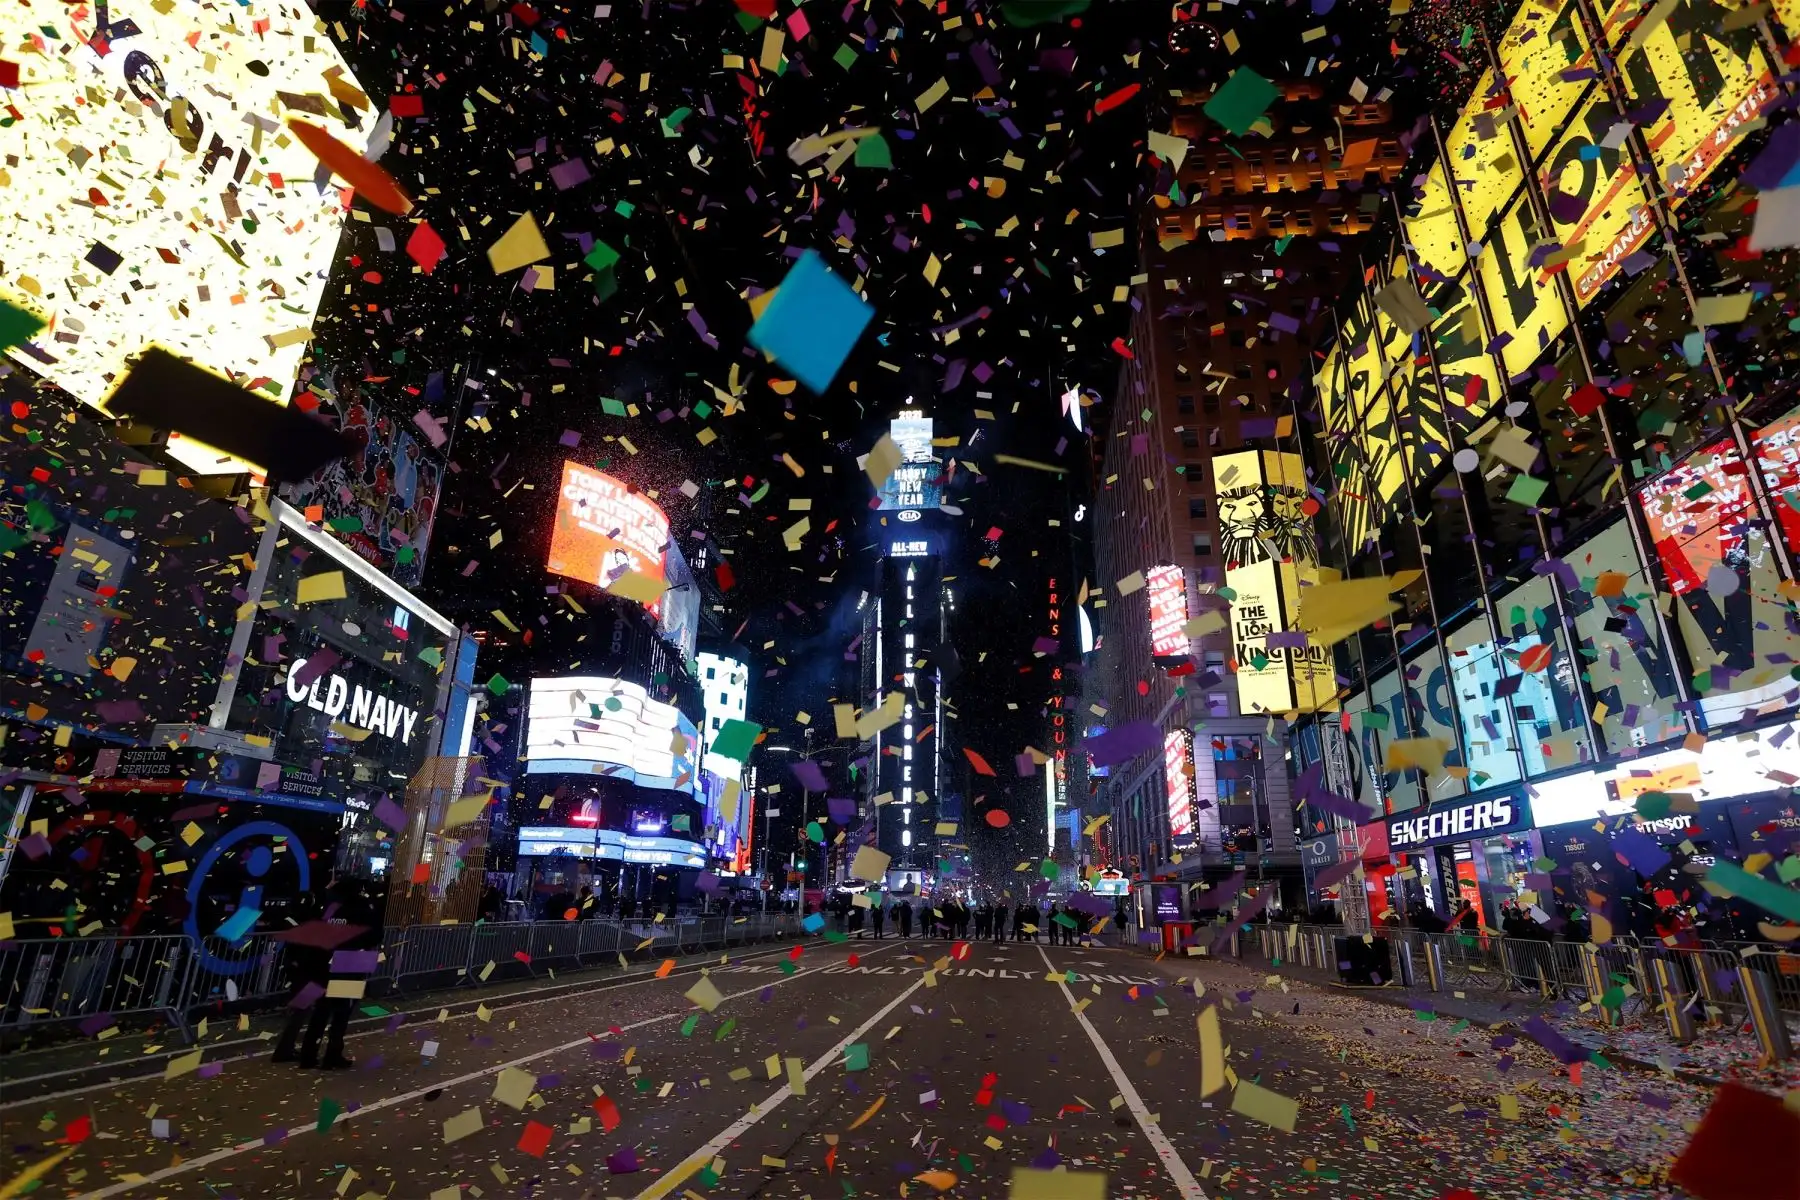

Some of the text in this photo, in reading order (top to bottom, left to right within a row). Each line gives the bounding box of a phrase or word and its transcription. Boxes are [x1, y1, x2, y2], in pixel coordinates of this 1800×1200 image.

[1580, 208, 1651, 295] ENTRANCE
[894, 467, 927, 481] HAPPY
[899, 481, 922, 493] NEW
[897, 493, 924, 505] YEAR
[901, 511, 920, 520] KIA
[891, 541, 928, 552] ALL-NEW
[905, 566, 915, 619] ALL
[1048, 578, 1061, 645] ERNS
[1238, 604, 1266, 619] THE
[1236, 621, 1273, 642] LION
[903, 633, 915, 688] NEW
[1236, 643, 1283, 668] KING
[1052, 668, 1063, 681] &
[349, 684, 419, 744] NAVY
[126, 751, 166, 763] VISITOR
[121, 763, 171, 775] SERVICES
[901, 703, 914, 847] SORENTO
[282, 781, 323, 795] SERVICES
[1390, 797, 1512, 846] SKECHERS
[1642, 815, 1692, 833] TISSOT
[1564, 842, 1585, 852] TISSOT
[1418, 856, 1436, 912] SKCHE
[822, 966, 927, 975] ONLY
[941, 968, 1040, 980] ONLY
[1072, 972, 1164, 986] ONLY
